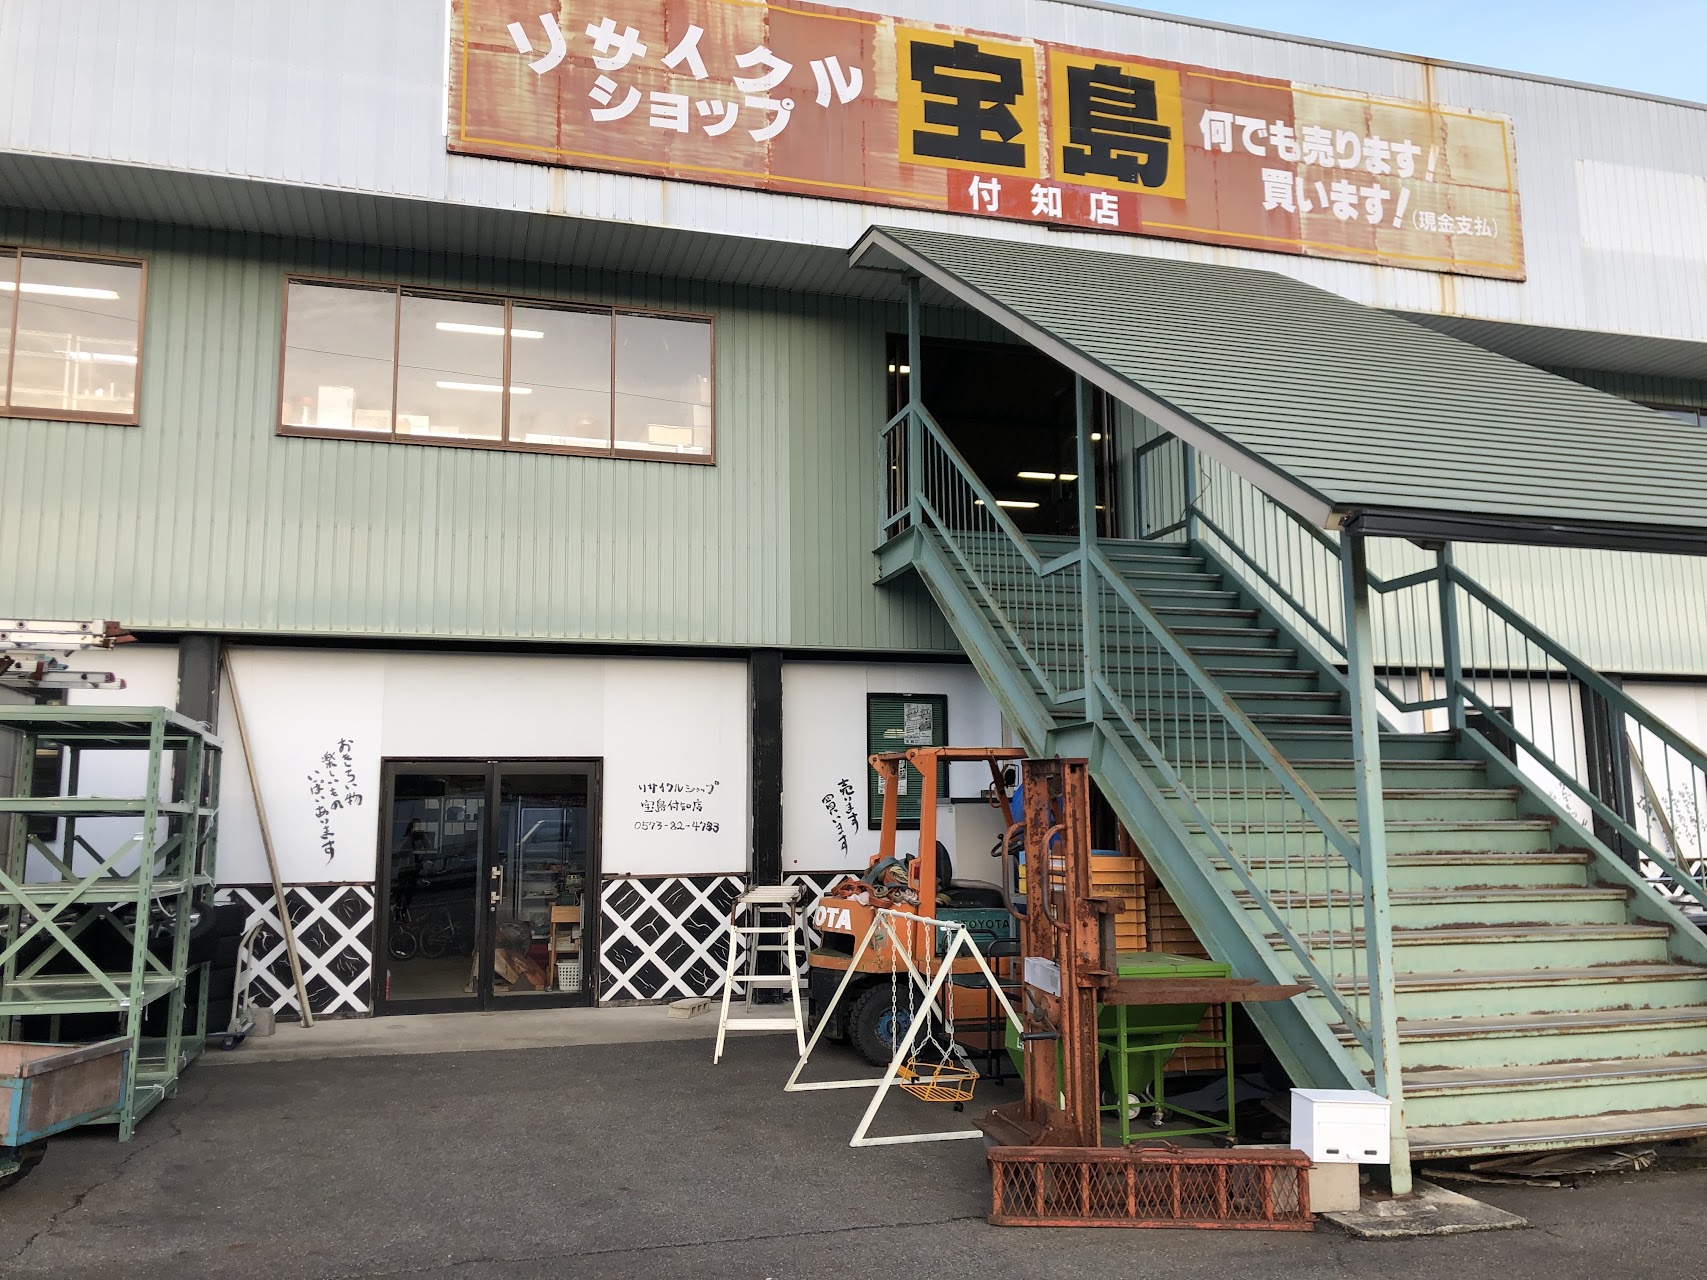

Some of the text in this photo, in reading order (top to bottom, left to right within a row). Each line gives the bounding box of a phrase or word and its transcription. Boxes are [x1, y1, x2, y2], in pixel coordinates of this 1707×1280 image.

[507, 13, 863, 108] リサイクル
[588, 75, 795, 142] ショップ
[910, 40, 1171, 188] 宝島
[968, 175, 1120, 227] 付知店
[321, 751, 344, 811] 楽しいもの
